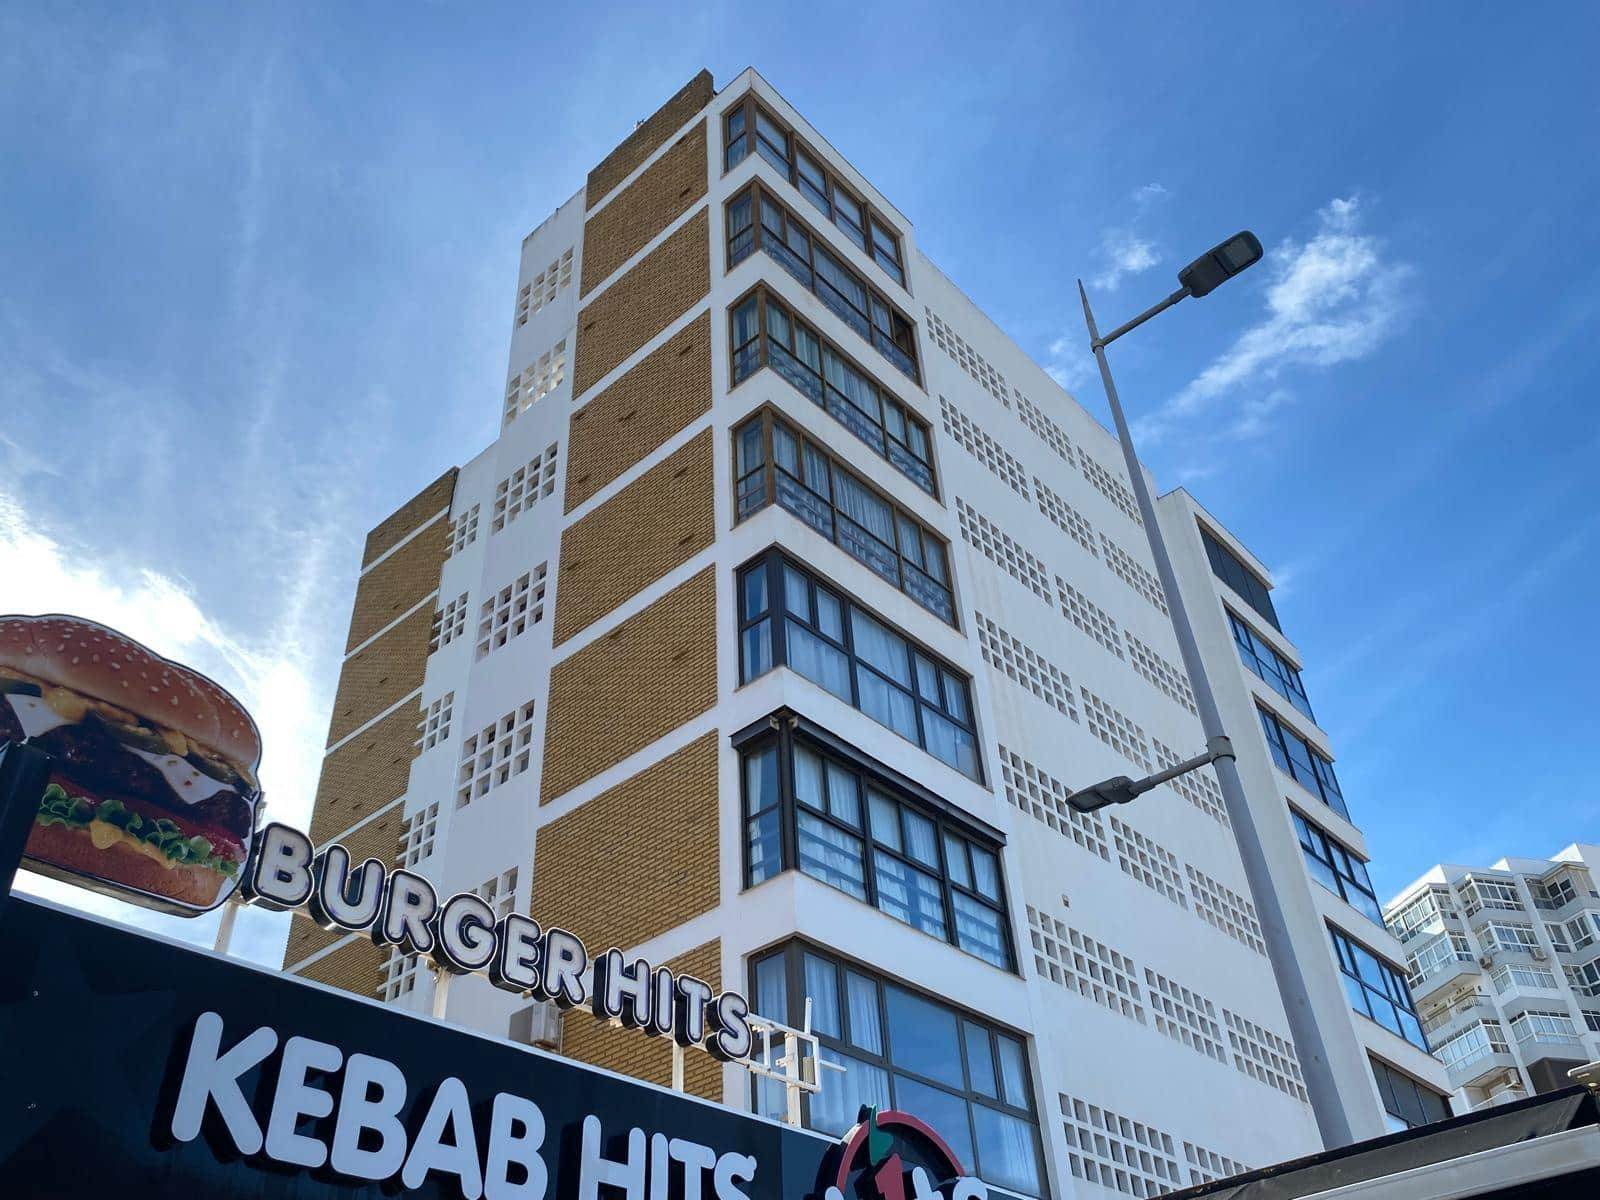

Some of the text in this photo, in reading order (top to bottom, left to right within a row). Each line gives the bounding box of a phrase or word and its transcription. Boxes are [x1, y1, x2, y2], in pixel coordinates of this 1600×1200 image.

[250, 821, 753, 1060] BURGER HITS
[171, 1011, 548, 1200] KEBAB
